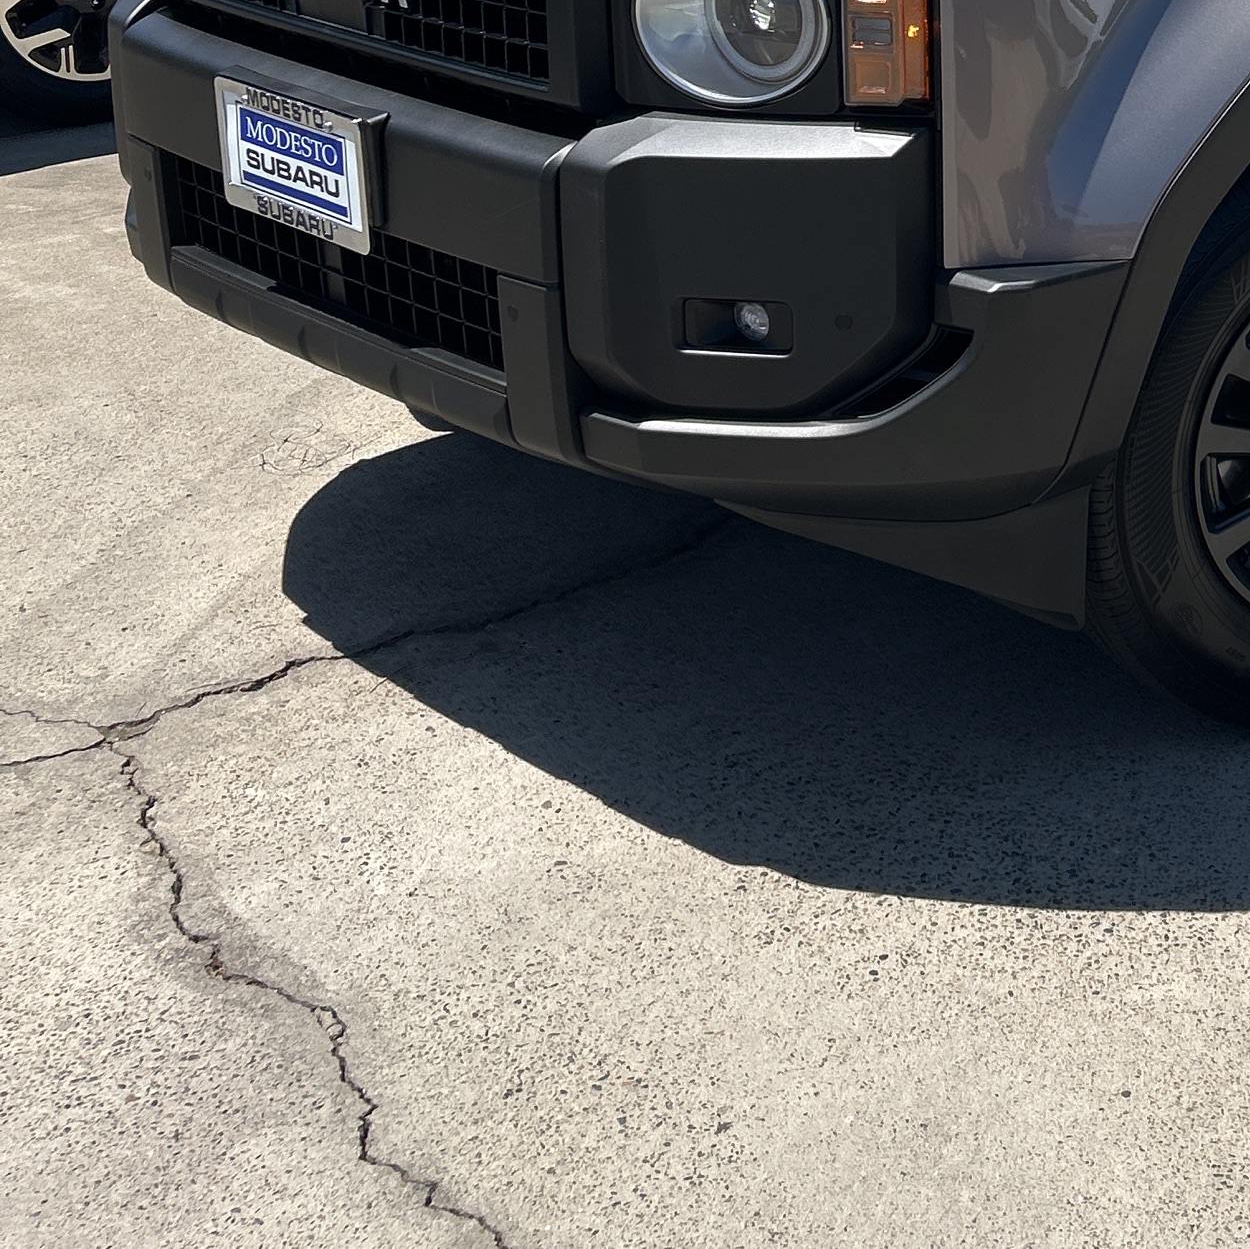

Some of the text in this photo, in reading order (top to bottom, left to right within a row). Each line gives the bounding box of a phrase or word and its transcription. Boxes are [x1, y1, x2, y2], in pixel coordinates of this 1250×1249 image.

[245, 86, 324, 128] MODESTO
[245, 117, 340, 167] MODESTO
[246, 147, 341, 198] SUBARU
